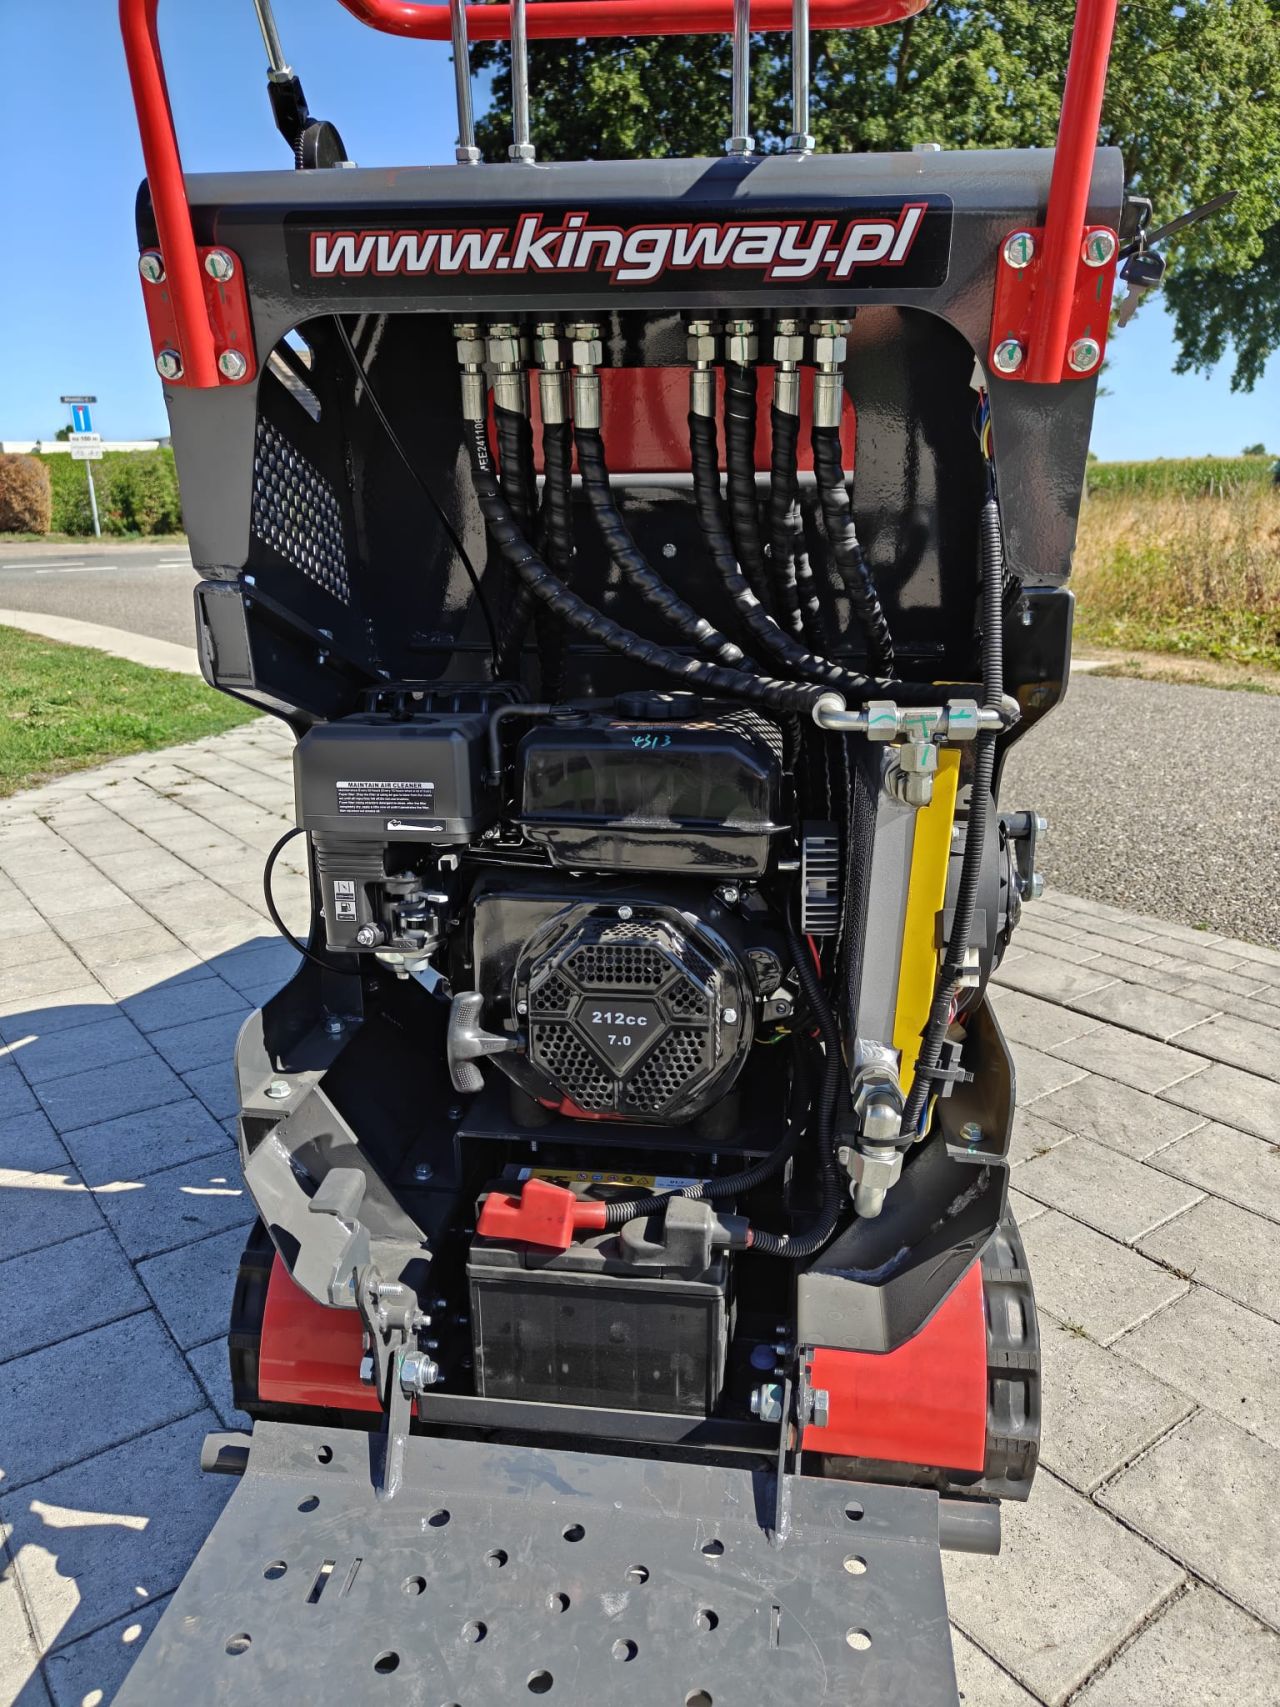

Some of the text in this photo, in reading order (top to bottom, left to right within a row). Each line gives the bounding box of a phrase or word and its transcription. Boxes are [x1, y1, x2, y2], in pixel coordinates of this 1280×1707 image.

[312, 204, 927, 284] www.kingway.pl
[631, 733, 672, 749] 4313
[592, 1011, 648, 1026] 212cc
[608, 1034, 632, 1046] 7.0
